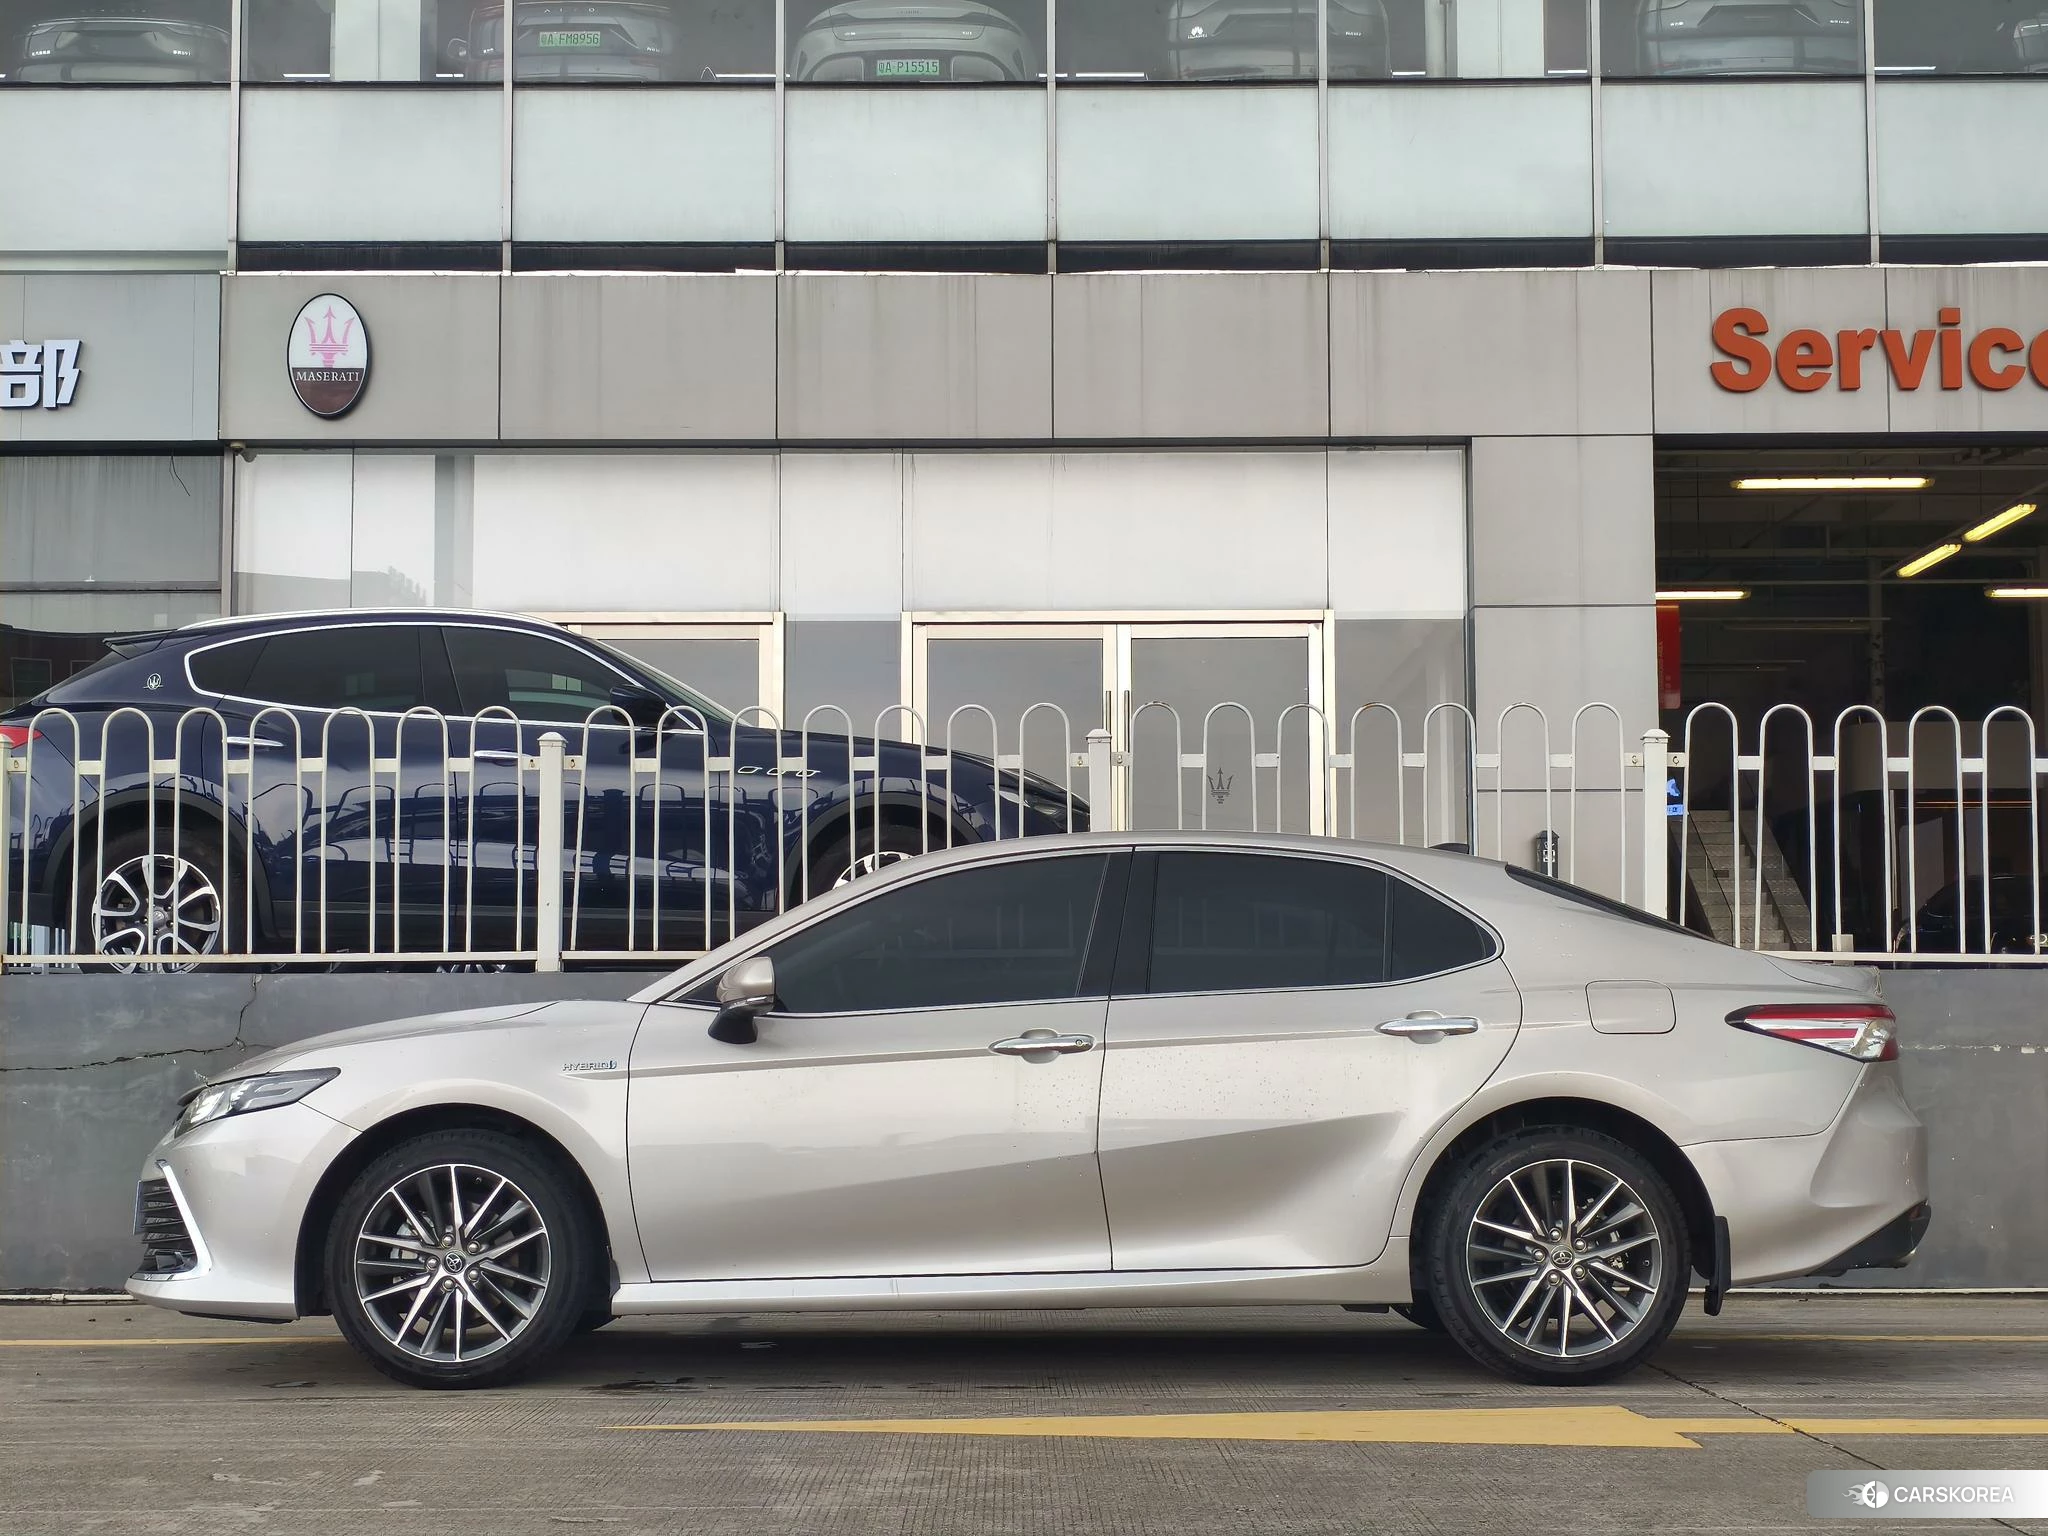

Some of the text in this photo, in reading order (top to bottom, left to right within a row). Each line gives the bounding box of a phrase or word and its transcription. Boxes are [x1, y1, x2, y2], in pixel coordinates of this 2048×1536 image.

[897, 61, 938, 73] P15515
[0, 339, 81, 409] 部
[295, 371, 360, 381] MASERATI
[562, 1062, 609, 1071] HYBRID
